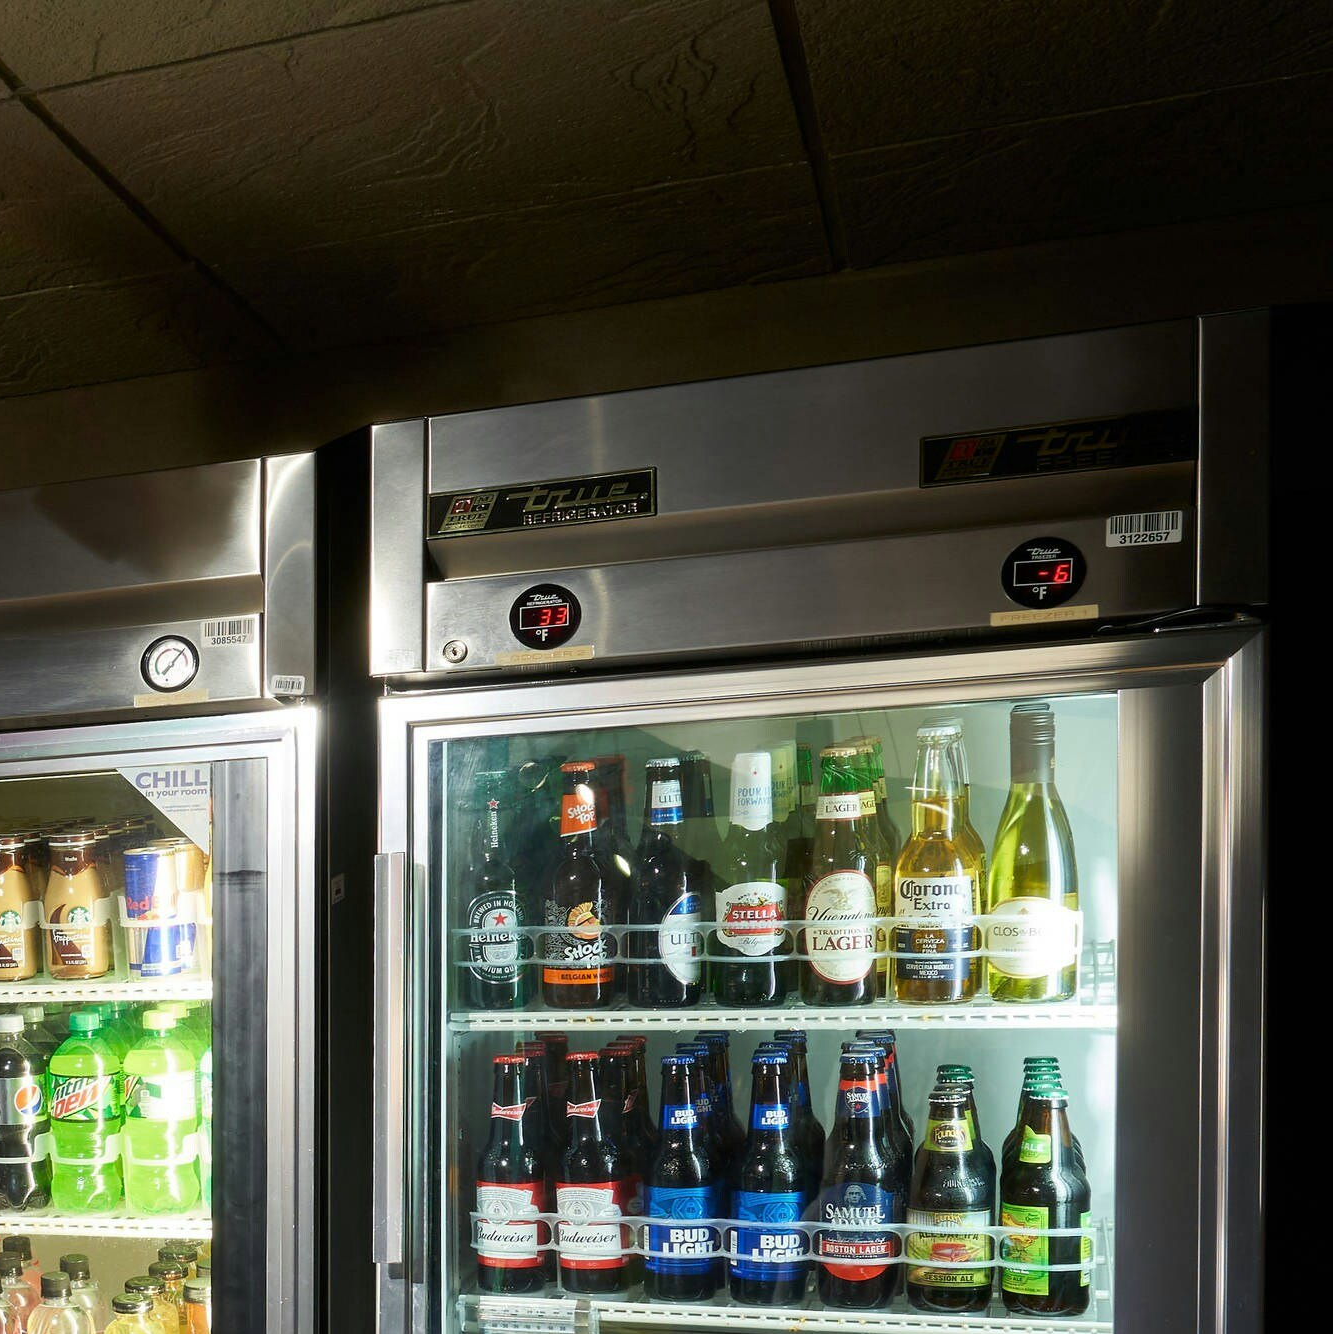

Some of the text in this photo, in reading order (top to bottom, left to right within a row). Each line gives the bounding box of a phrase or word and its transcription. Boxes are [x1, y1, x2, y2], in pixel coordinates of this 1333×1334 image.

[523, 503, 638, 525] REFRIGERATOR
[1119, 532, 1171, 545] 3122657
[1039, 564, 1070, 583] -6
[539, 607, 567, 627] 33
[211, 635, 247, 646] 3085547
[135, 769, 208, 789] CHILL
[156, 789, 179, 799] your
[181, 788, 207, 796] room
[825, 802, 858, 813] LAGER
[575, 810, 596, 824] TOP
[490, 811, 499, 848] Heineken
[913, 898, 951, 910] Extra
[732, 908, 778, 920] STELLA
[816, 927, 872, 936] TRADITIONAL
[993, 926, 1019, 937] CLOS
[812, 934, 874, 951] LAGER
[564, 939, 608, 961] SHOCK
[561, 973, 591, 981] BELGIAN
[674, 1109, 695, 1117] BUD
[765, 1109, 786, 1117] BUD
[670, 1115, 697, 1126] LIGHT
[761, 1115, 789, 1126] LIGHT
[825, 1203, 885, 1220] SAMUEL
[477, 1225, 534, 1244] Budweiser
[559, 1227, 617, 1244] Budweiser
[669, 1227, 710, 1243] BUD
[662, 1240, 715, 1256] LIGHT
[759, 1233, 801, 1250] BUD
[752, 1246, 803, 1263] LIGHT
[825, 1243, 887, 1255] BOSTON LAGER
[924, 1271, 974, 1283] SESSION ALE
